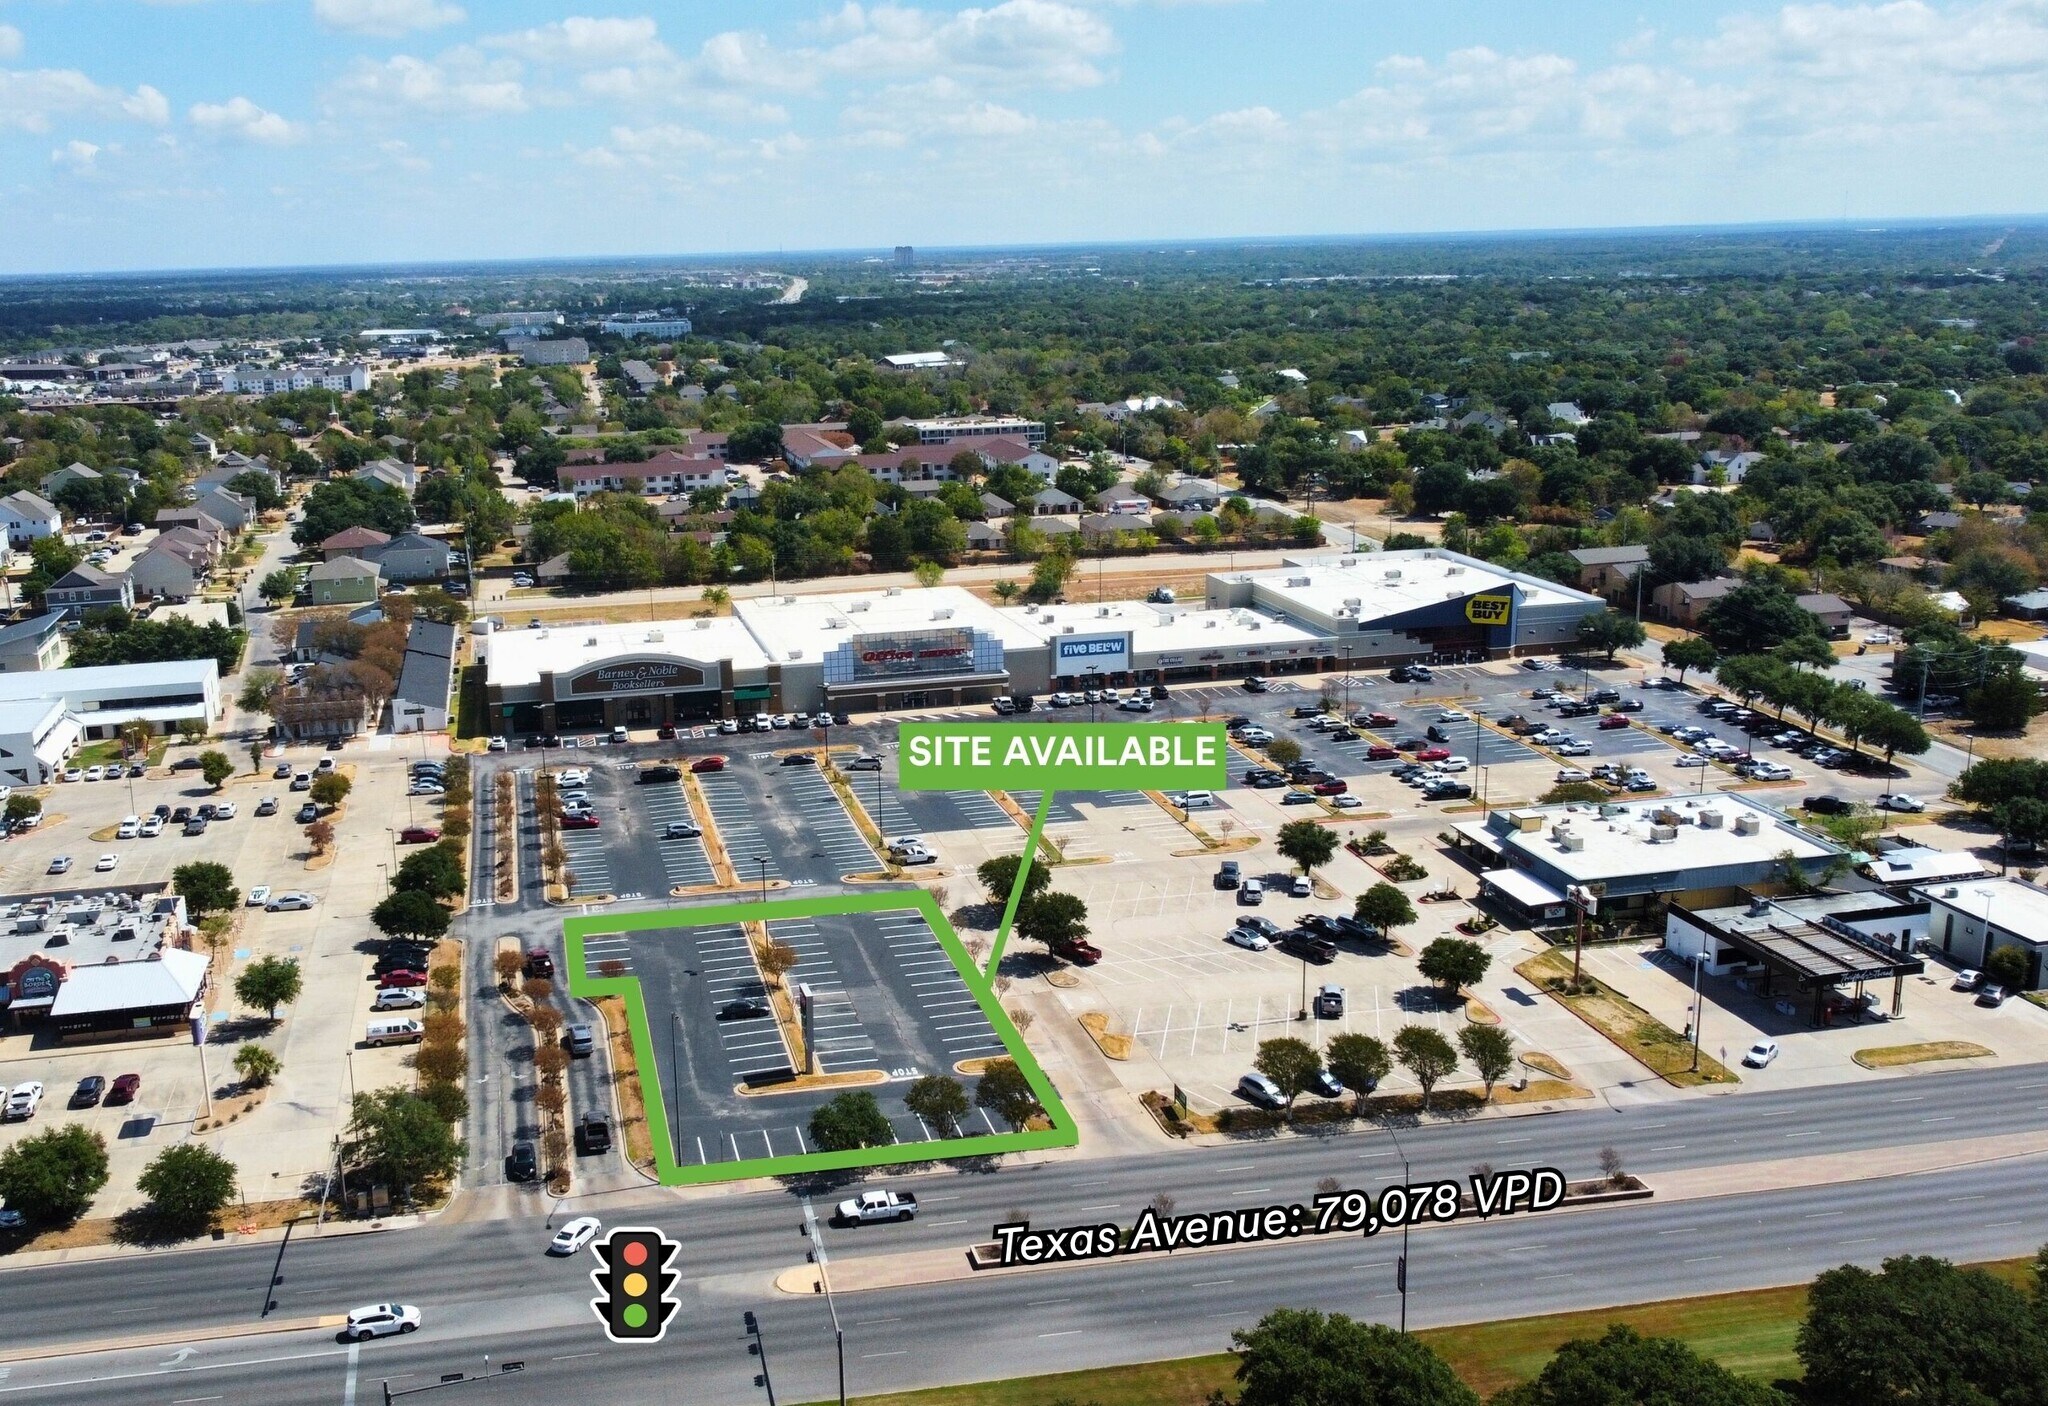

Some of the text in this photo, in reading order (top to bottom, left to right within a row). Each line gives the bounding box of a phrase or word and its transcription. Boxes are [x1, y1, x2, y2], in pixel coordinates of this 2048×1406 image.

[1471, 600, 1508, 610] BEST
[1472, 609, 1503, 619] BUY
[1063, 643, 1087, 655] five
[597, 665, 678, 680] Barnes & Noble
[612, 679, 665, 690] Booksellers
[891, 1066, 919, 1077] STOP
